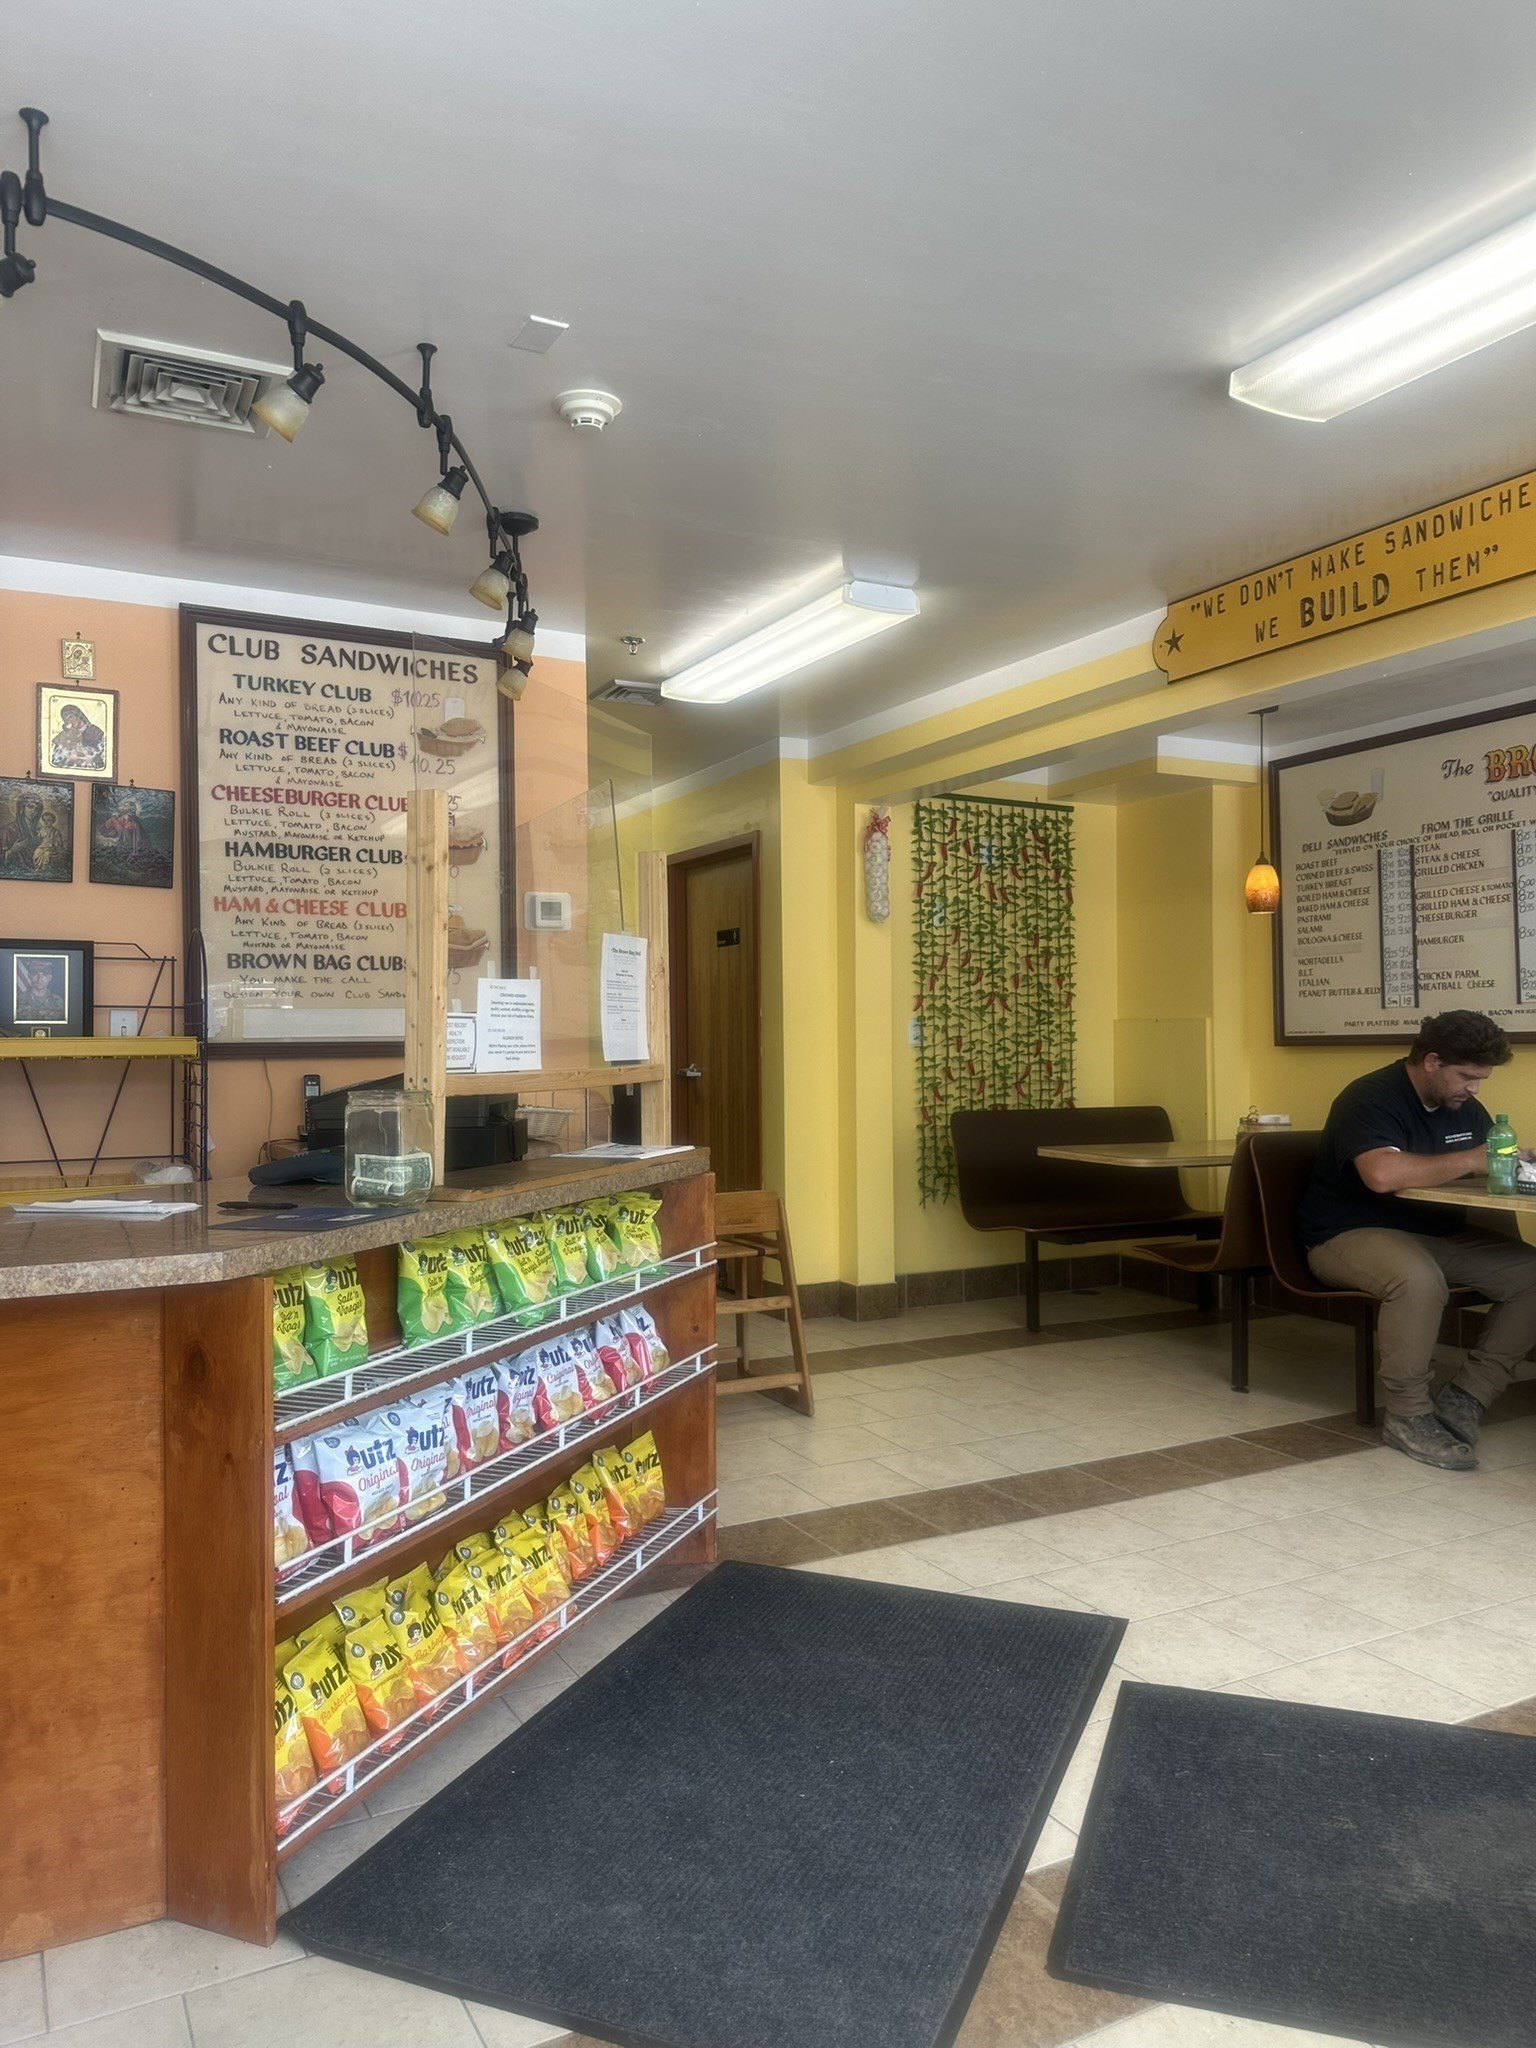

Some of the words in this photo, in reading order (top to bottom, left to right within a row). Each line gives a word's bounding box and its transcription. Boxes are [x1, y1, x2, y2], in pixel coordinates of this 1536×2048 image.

[1240, 568, 1293, 606] DON'T
[1311, 542, 1365, 581] MAKE
[1255, 617, 1279, 643] WE
[1300, 573, 1390, 629] BUILD
[208, 634, 280, 660] CLUB
[301, 644, 478, 684] SANDWICHES
[232, 674, 316, 696] TURKEY
[321, 684, 372, 702] CLUB
[219, 692, 242, 704] ANY
[251, 699, 276, 708] KIND
[304, 703, 342, 713] BREAD
[360, 706, 394, 719] SLICES)
[234, 710, 287, 722] LETTUCE,
[290, 714, 337, 726] TOMATO,
[340, 717, 374, 726] BACON
[287, 724, 346, 735] MAYONAISE
[220, 729, 289, 749] ROAST
[295, 736, 340, 753] BEEF
[345, 740, 395, 758] CLUB
[219, 748, 239, 760] ANY
[245, 753, 273, 761] KIND
[301, 756, 337, 765] BREAD
[358, 759, 395, 772] SLICES)
[1442, 759, 1474, 779] The
[1484, 744, 1536, 784] BR
[236, 764, 290, 775] LETTUCE,
[294, 767, 339, 779] TOMATO,
[341, 770, 374, 778] BACON
[287, 777, 343, 788] MAYONAISE
[211, 784, 360, 809] CHEESEBURGER
[230, 805, 272, 816] BULKIE
[278, 806, 310, 818] ROLL
[336, 812, 375, 824] SLICES)
[1421, 820, 1450, 835] FROM
[1454, 816, 1474, 829] THE
[1478, 810, 1514, 826] GRILLE
[224, 818, 277, 829] LETTUCE,
[333, 822, 367, 831] BACON
[1496, 820, 1526, 830] POCKET
[234, 829, 281, 839] MUSTARD,
[284, 832, 330, 840] MAYONAISE
[348, 834, 385, 842] KETCHUP
[1302, 842, 1322, 853] DELI
[1327, 830, 1388, 850] SANDWICHES
[225, 841, 351, 862] HAMBURGER
[1415, 843, 1441, 854] STEAK
[1415, 855, 1441, 865] STEAK
[1451, 848, 1481, 860] CHEESE
[233, 860, 275, 872] BULKIE
[281, 862, 310, 873] ROLL
[337, 867, 378, 878] SLICES)
[1415, 865, 1449, 877] GRILLED
[1451, 860, 1484, 872] CHICKEN
[328, 878, 361, 886] BACON
[224, 885, 268, 894] MUSTARD,
[271, 886, 320, 894] MAYONAISE
[342, 889, 378, 897] KETCHUP
[1415, 889, 1448, 900] GRILLED
[1450, 885, 1480, 896] CHEESE
[213, 896, 260, 913] HAM
[265, 899, 279, 914] &
[282, 899, 349, 916] CHEESE
[356, 902, 407, 919] CLUB
[1416, 901, 1448, 911] GRILLED
[1451, 898, 1469, 908] HAM
[1479, 894, 1511, 905] CHEESE
[235, 915, 254, 925] ANY
[262, 917, 286, 927] KIND
[316, 920, 348, 930] BREAD
[365, 923, 394, 932] SLICES)
[1297, 914, 1331, 924] PASTRAMI
[1416, 910, 1478, 923] CHEESEBURGER
[231, 930, 287, 940] LETTUCE,
[290, 932, 334, 942] TOMATO,
[336, 933, 368, 941] BACON
[1417, 935, 1465, 945] HAMBURGER
[296, 942, 346, 951] MAYONAISE
[227, 953, 307, 969] BROWN
[314, 954, 351, 971] BAG
[274, 976, 307, 984] MAKE
[341, 976, 372, 984] CALL
[1298, 979, 1330, 987] ITALIAN
[1418, 972, 1452, 980] CHICKEN
[1299, 989, 1327, 998] PEANUT
[1418, 982, 1462, 990] MEATBALL
[345, 990, 371, 999] CLUB
[466, 1396, 496, 1418] Original
[358, 1458, 400, 1491] Original
